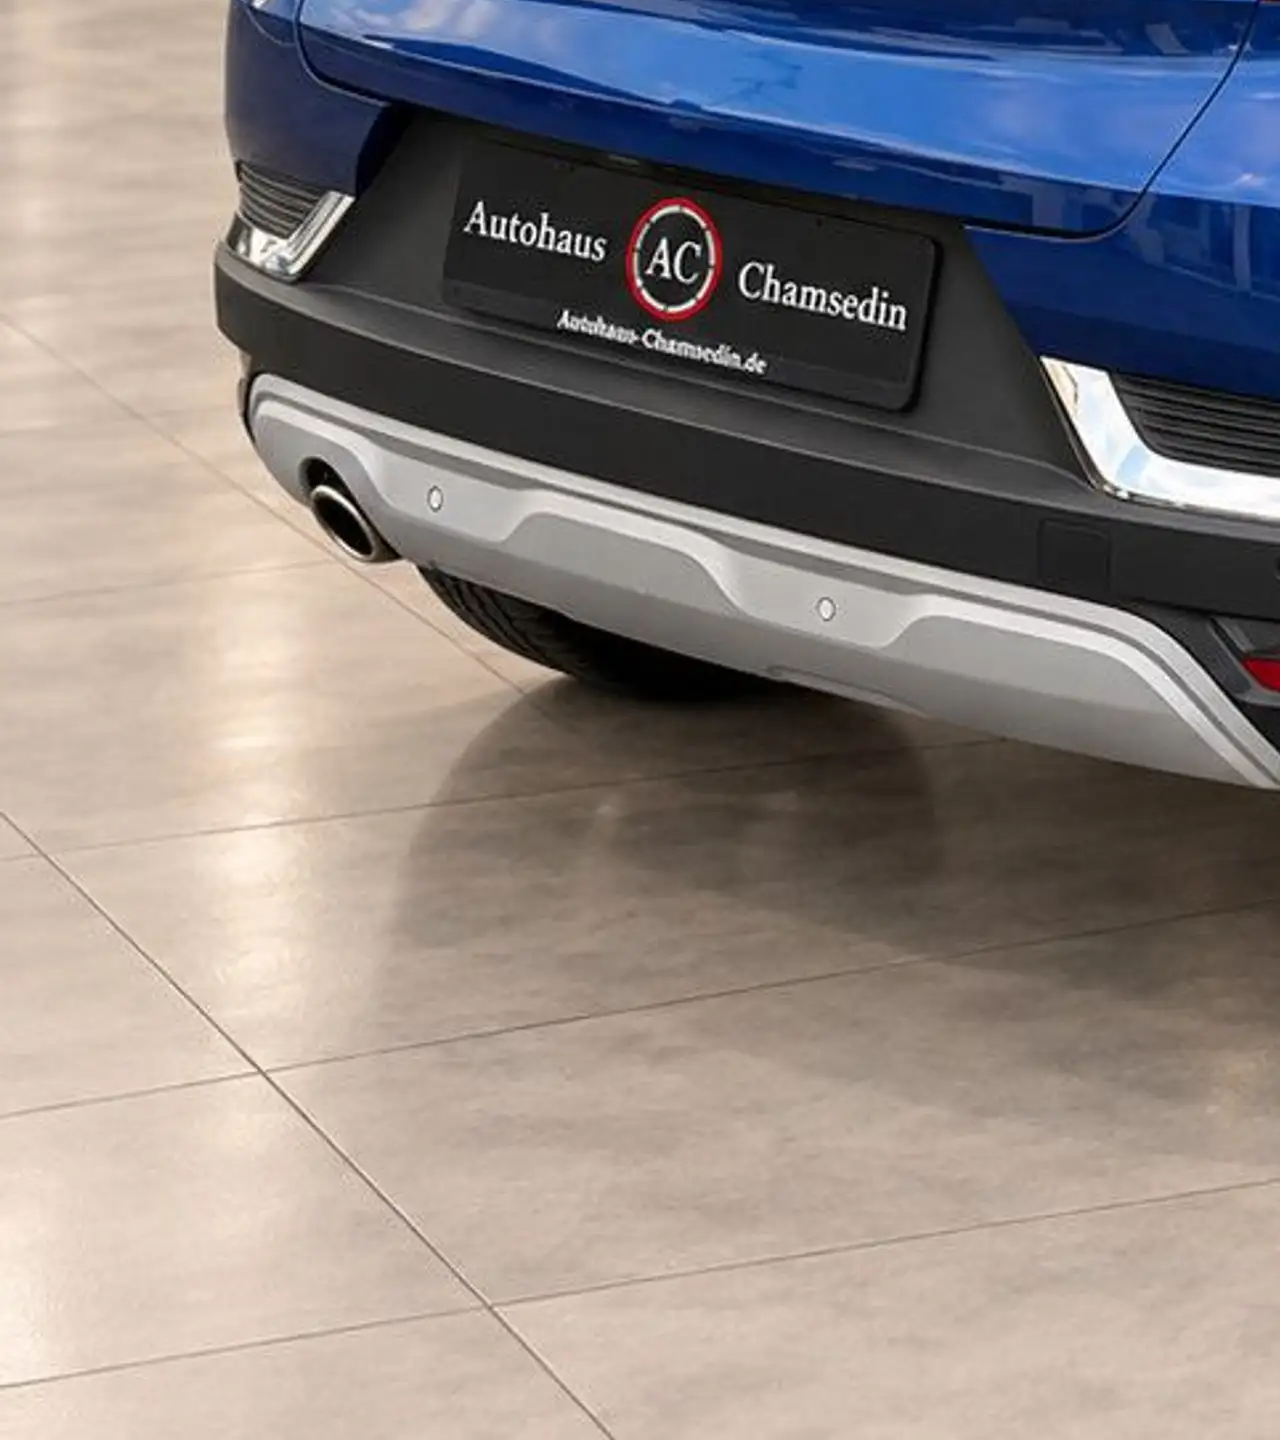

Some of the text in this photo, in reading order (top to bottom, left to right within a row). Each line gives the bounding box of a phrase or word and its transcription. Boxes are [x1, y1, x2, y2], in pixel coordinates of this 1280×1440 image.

[463, 200, 607, 262] Autohaus
[646, 237, 700, 285] AC
[738, 261, 908, 330] Chamsedin
